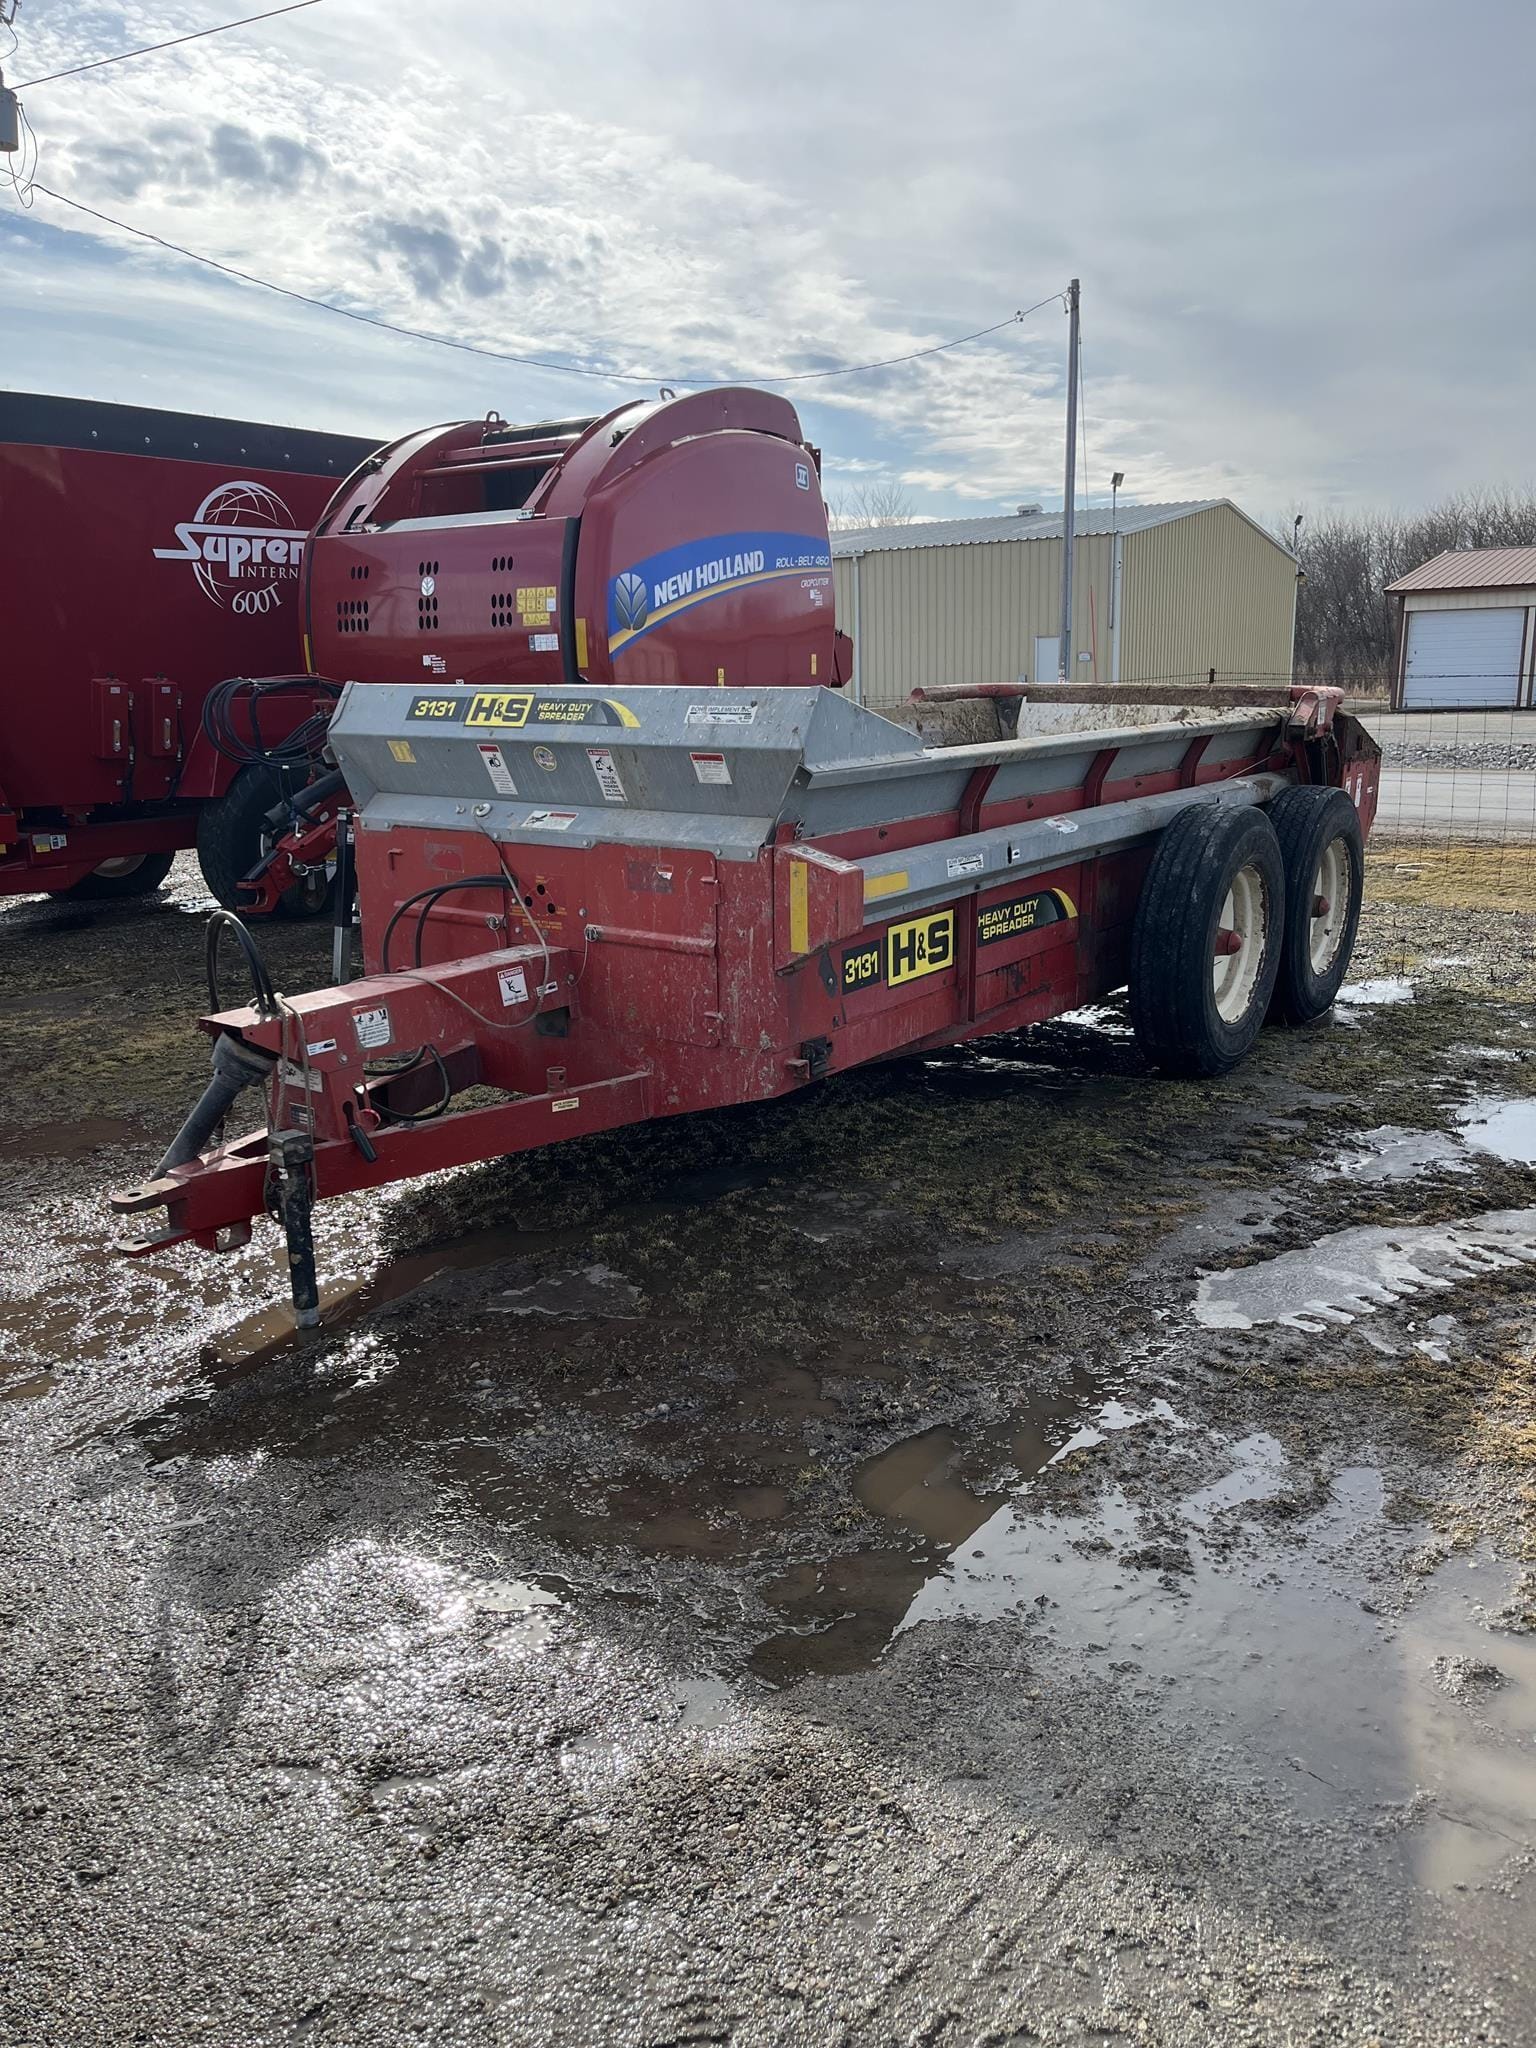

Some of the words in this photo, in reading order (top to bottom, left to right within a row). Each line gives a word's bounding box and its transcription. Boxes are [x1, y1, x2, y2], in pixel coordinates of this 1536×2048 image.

[654, 569, 693, 608] NEW
[695, 550, 765, 589] HOLLAND
[232, 581, 283, 614] 600T
[414, 700, 457, 717] 3131
[470, 697, 529, 723] H&S
[537, 702, 567, 711] HEAVY
[568, 703, 594, 712] DUTY
[538, 711, 585, 721] SPREADER
[978, 906, 1011, 927] HEAVY
[1014, 899, 1039, 916] DUTY
[983, 913, 1034, 940] SPREADER
[845, 951, 878, 984] 3131
[893, 918, 950, 978] H&S
